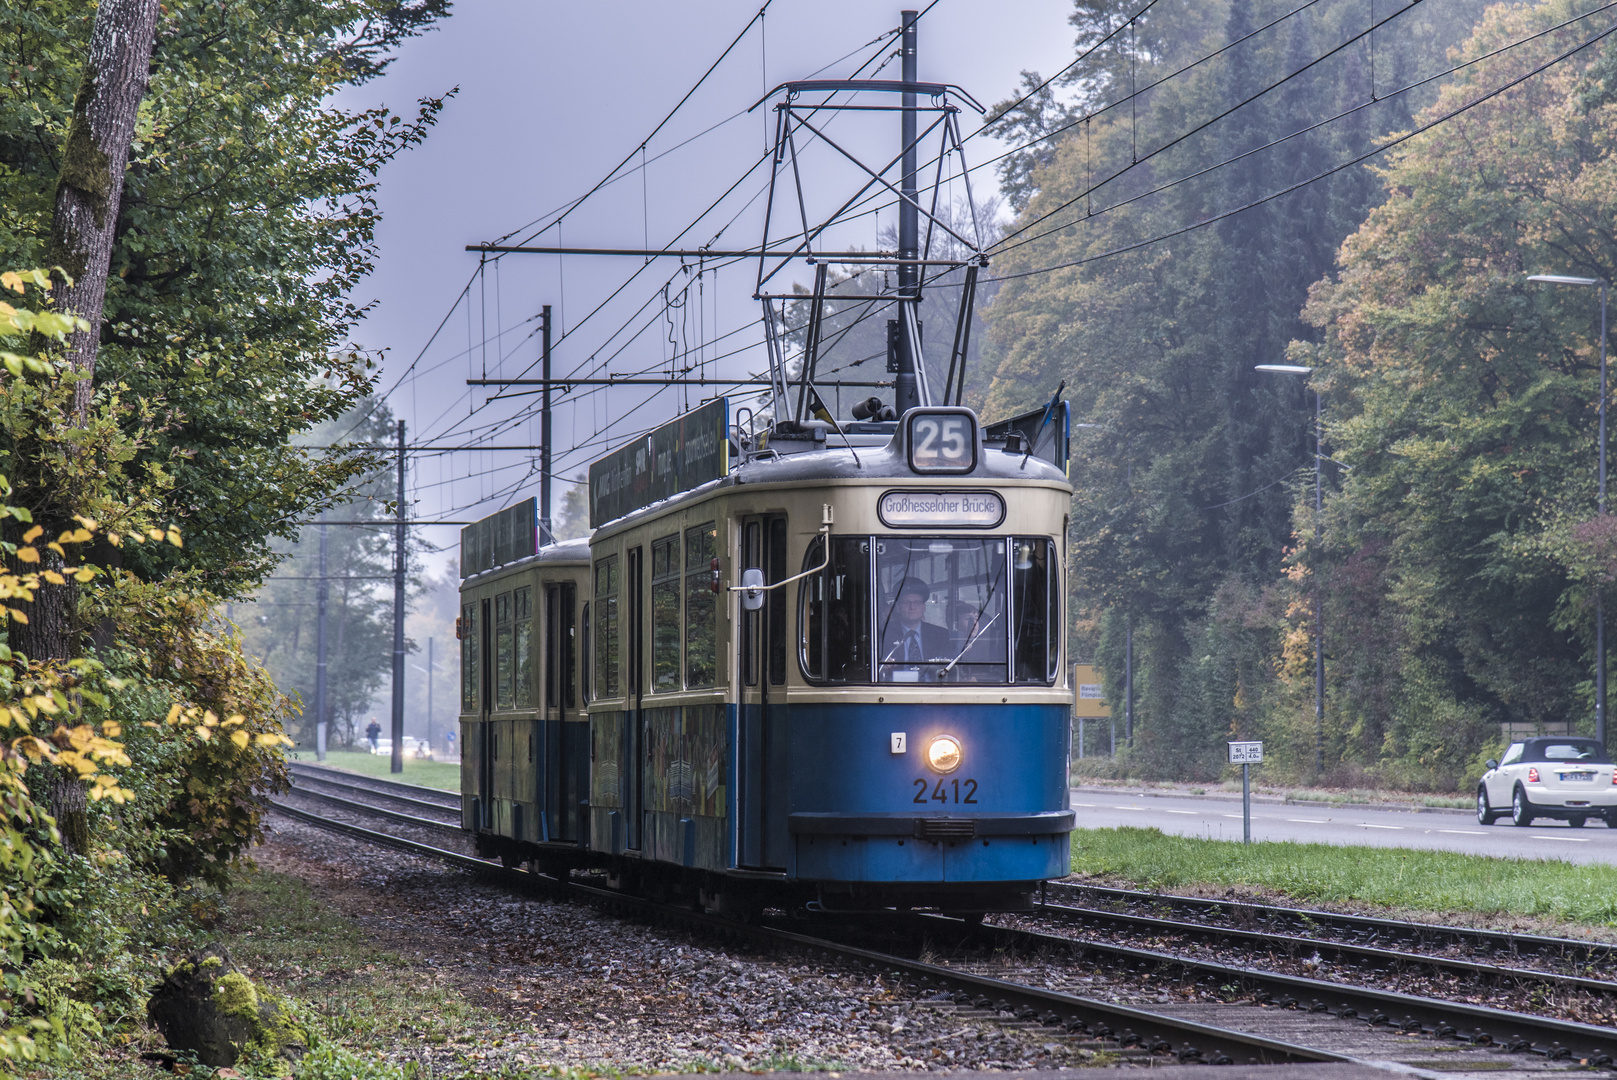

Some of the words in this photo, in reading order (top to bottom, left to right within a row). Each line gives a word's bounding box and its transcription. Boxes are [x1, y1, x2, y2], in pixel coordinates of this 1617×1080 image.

[915, 419, 965, 459] 25
[885, 498, 959, 513] Großhesseloher
[962, 498, 995, 513] Brücke
[895, 737, 902, 749] 7
[913, 778, 978, 804] 2412
